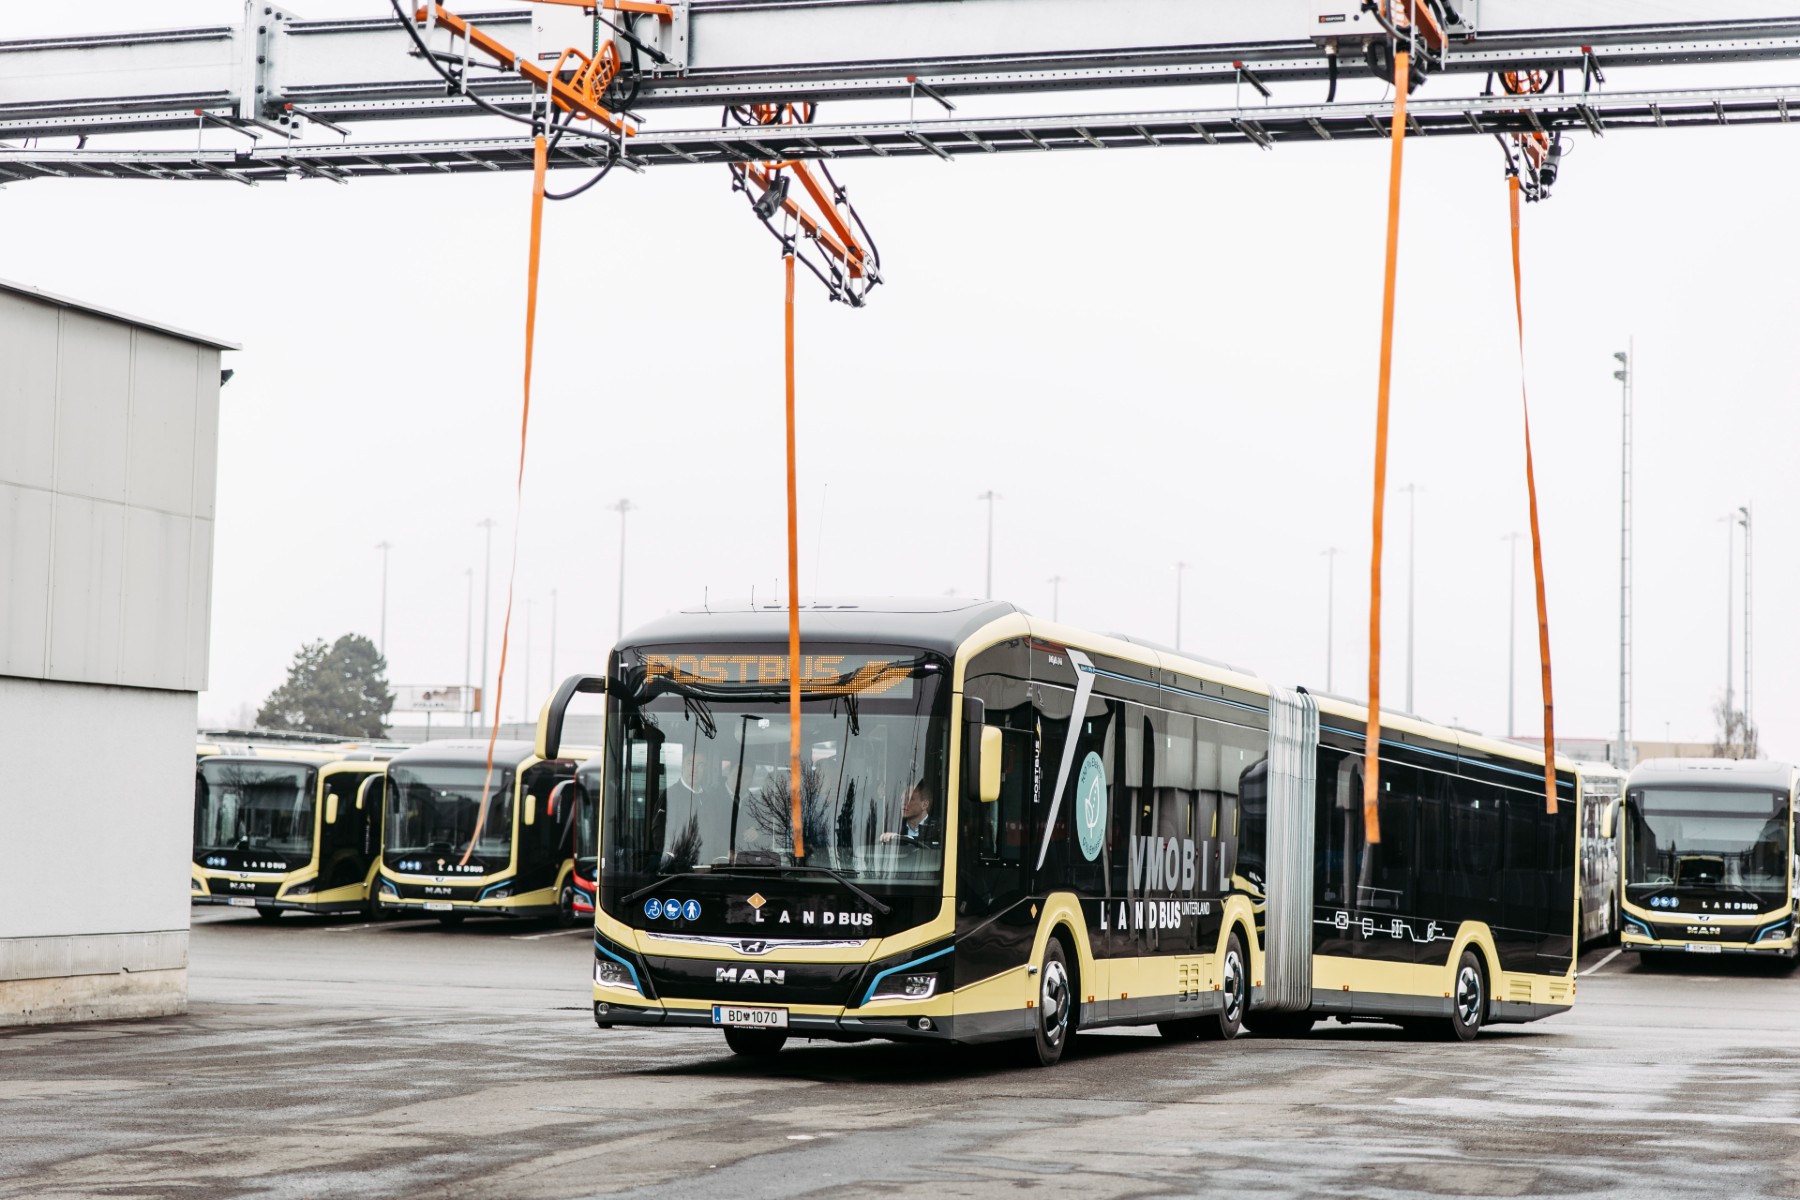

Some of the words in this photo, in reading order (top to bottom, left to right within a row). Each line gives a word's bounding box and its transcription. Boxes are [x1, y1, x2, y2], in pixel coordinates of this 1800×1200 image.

[646, 655, 844, 684] POSTBUS
[1131, 835, 1230, 891] VMOBIL
[1181, 902, 1210, 915] UNTERLAND
[716, 967, 785, 985] MAN
